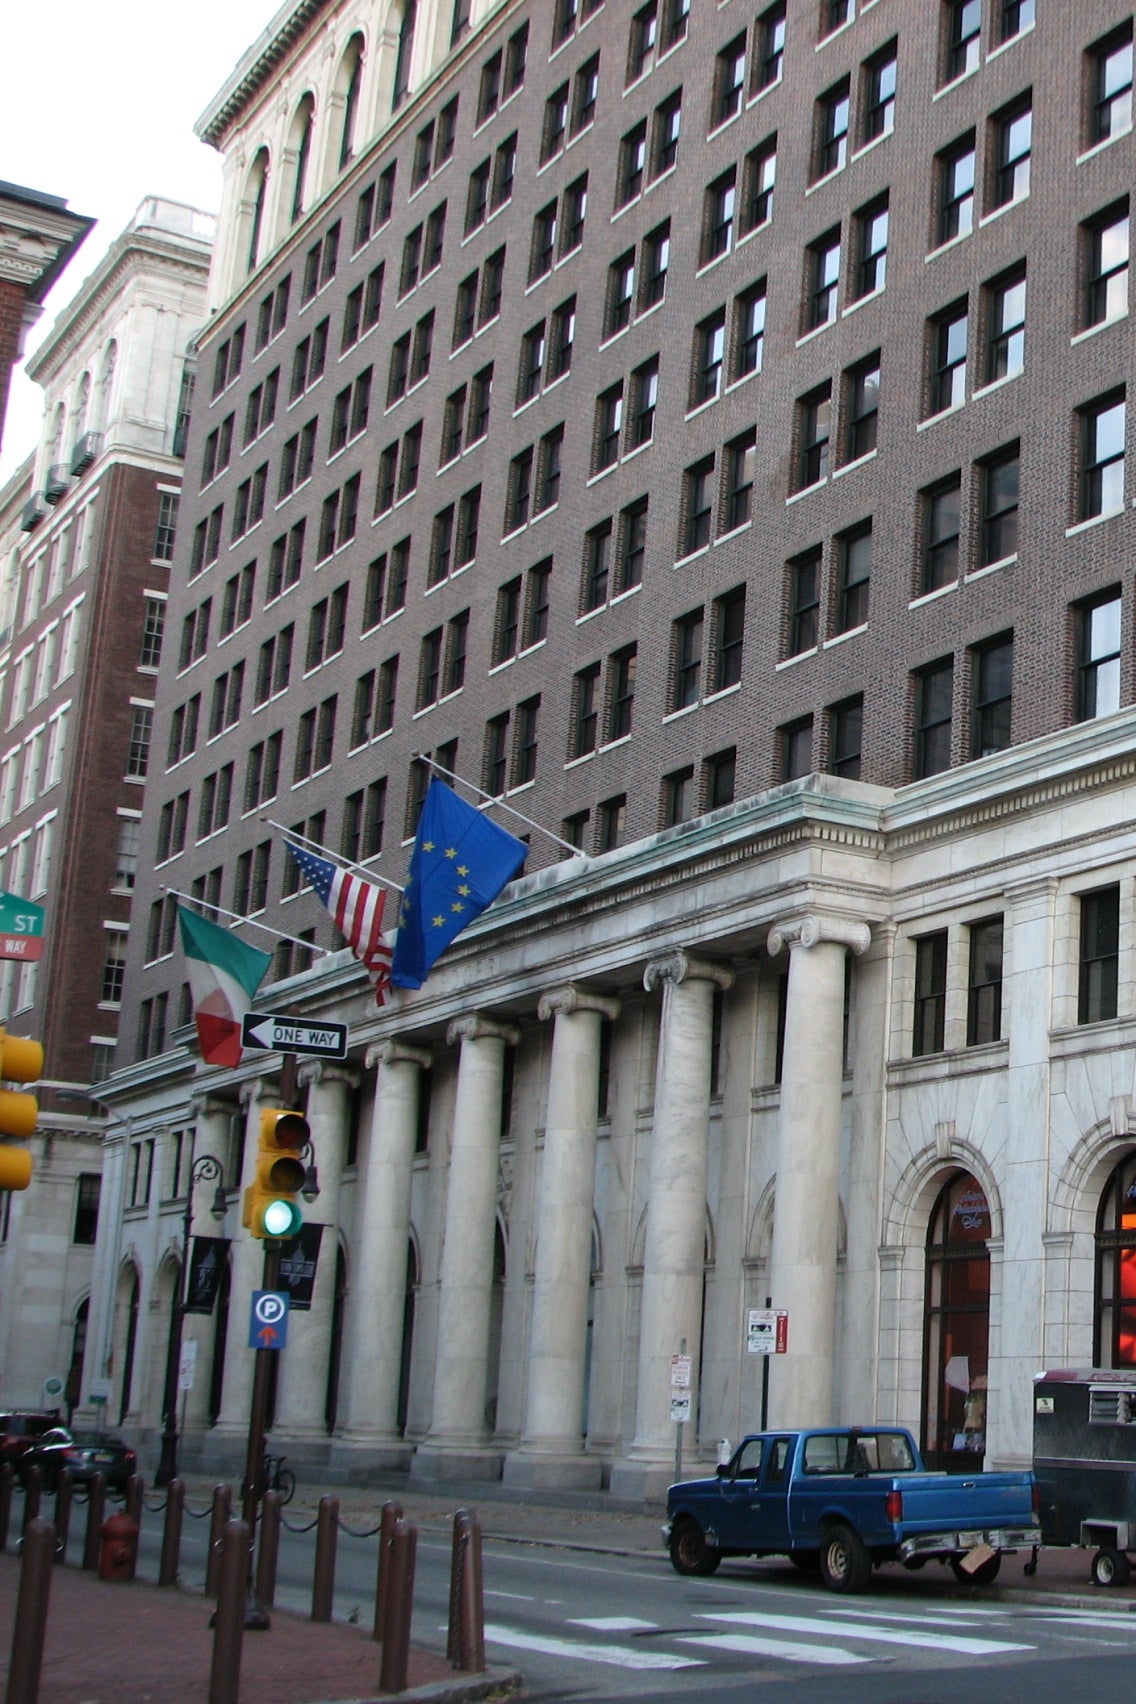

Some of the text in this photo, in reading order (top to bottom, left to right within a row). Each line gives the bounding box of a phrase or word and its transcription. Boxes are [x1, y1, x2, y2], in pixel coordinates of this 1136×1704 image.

[14, 914, 38, 933] ST
[5, 939, 28, 954] WAY
[274, 1028, 336, 1047] ONE WAY
[263, 1301, 278, 1317] P
